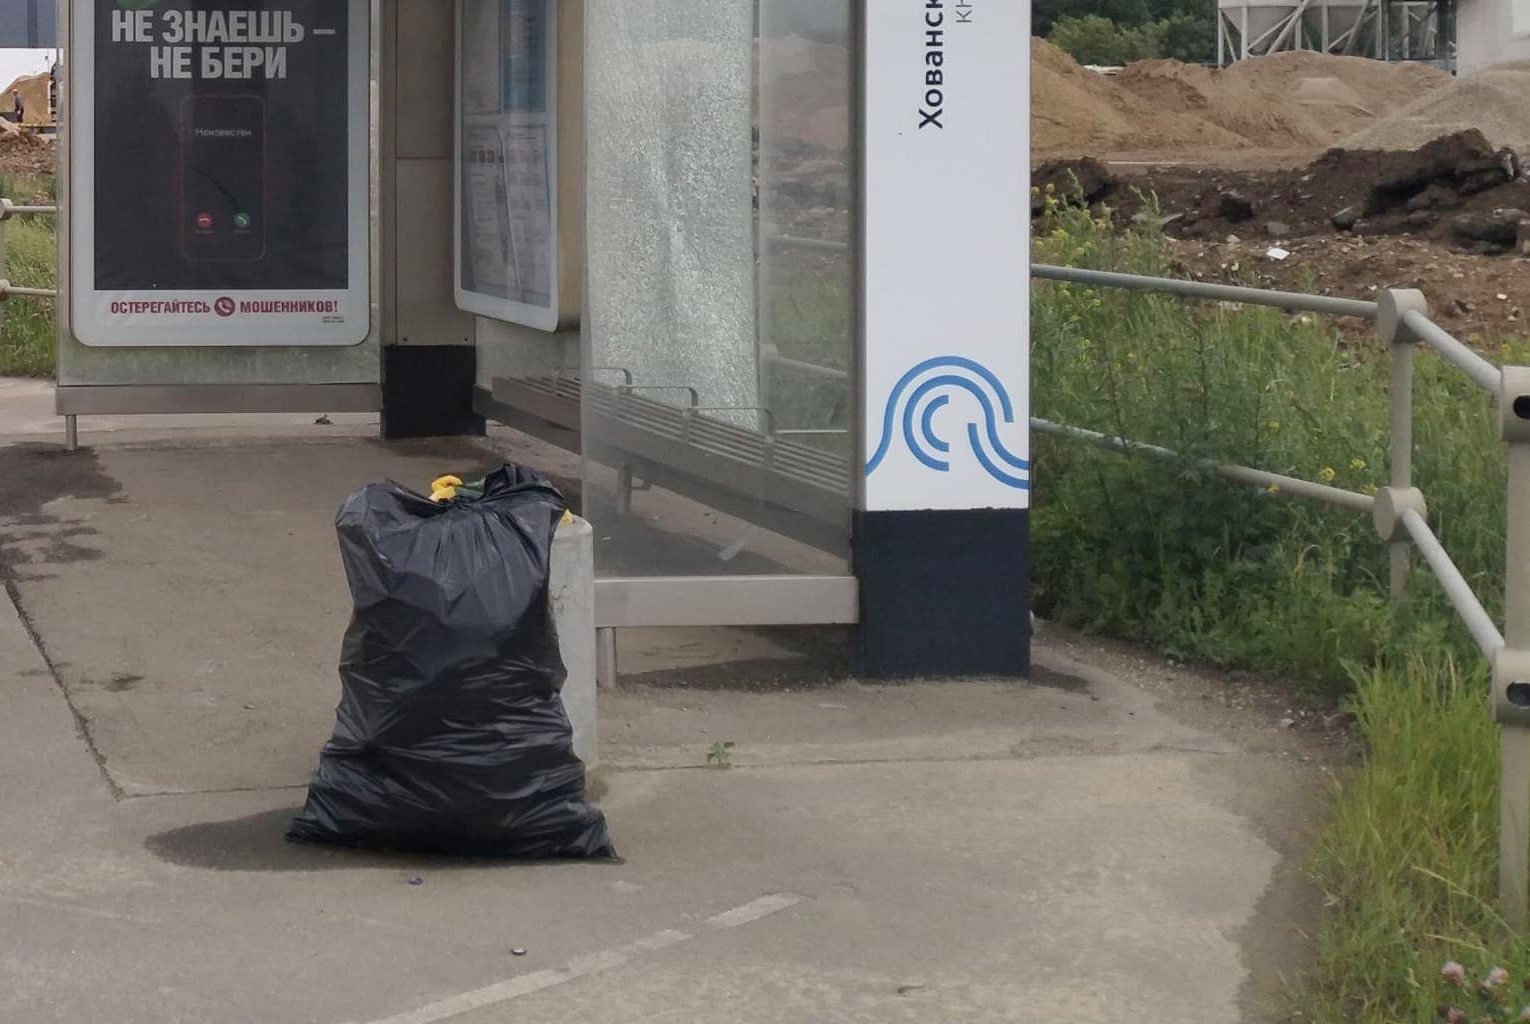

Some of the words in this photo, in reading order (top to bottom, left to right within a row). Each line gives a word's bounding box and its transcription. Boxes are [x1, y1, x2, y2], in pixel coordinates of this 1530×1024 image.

[112, 10, 153, 42] НЕ
[162, 10, 304, 42] ЗНАЕШЬ
[150, 47, 192, 79] НЕ
[201, 47, 287, 79] БЕРИ
[111, 299, 210, 314] ОСТЕРЕГАЙТЕСЬ
[240, 300, 338, 314] МОШЕННИКОВ!
